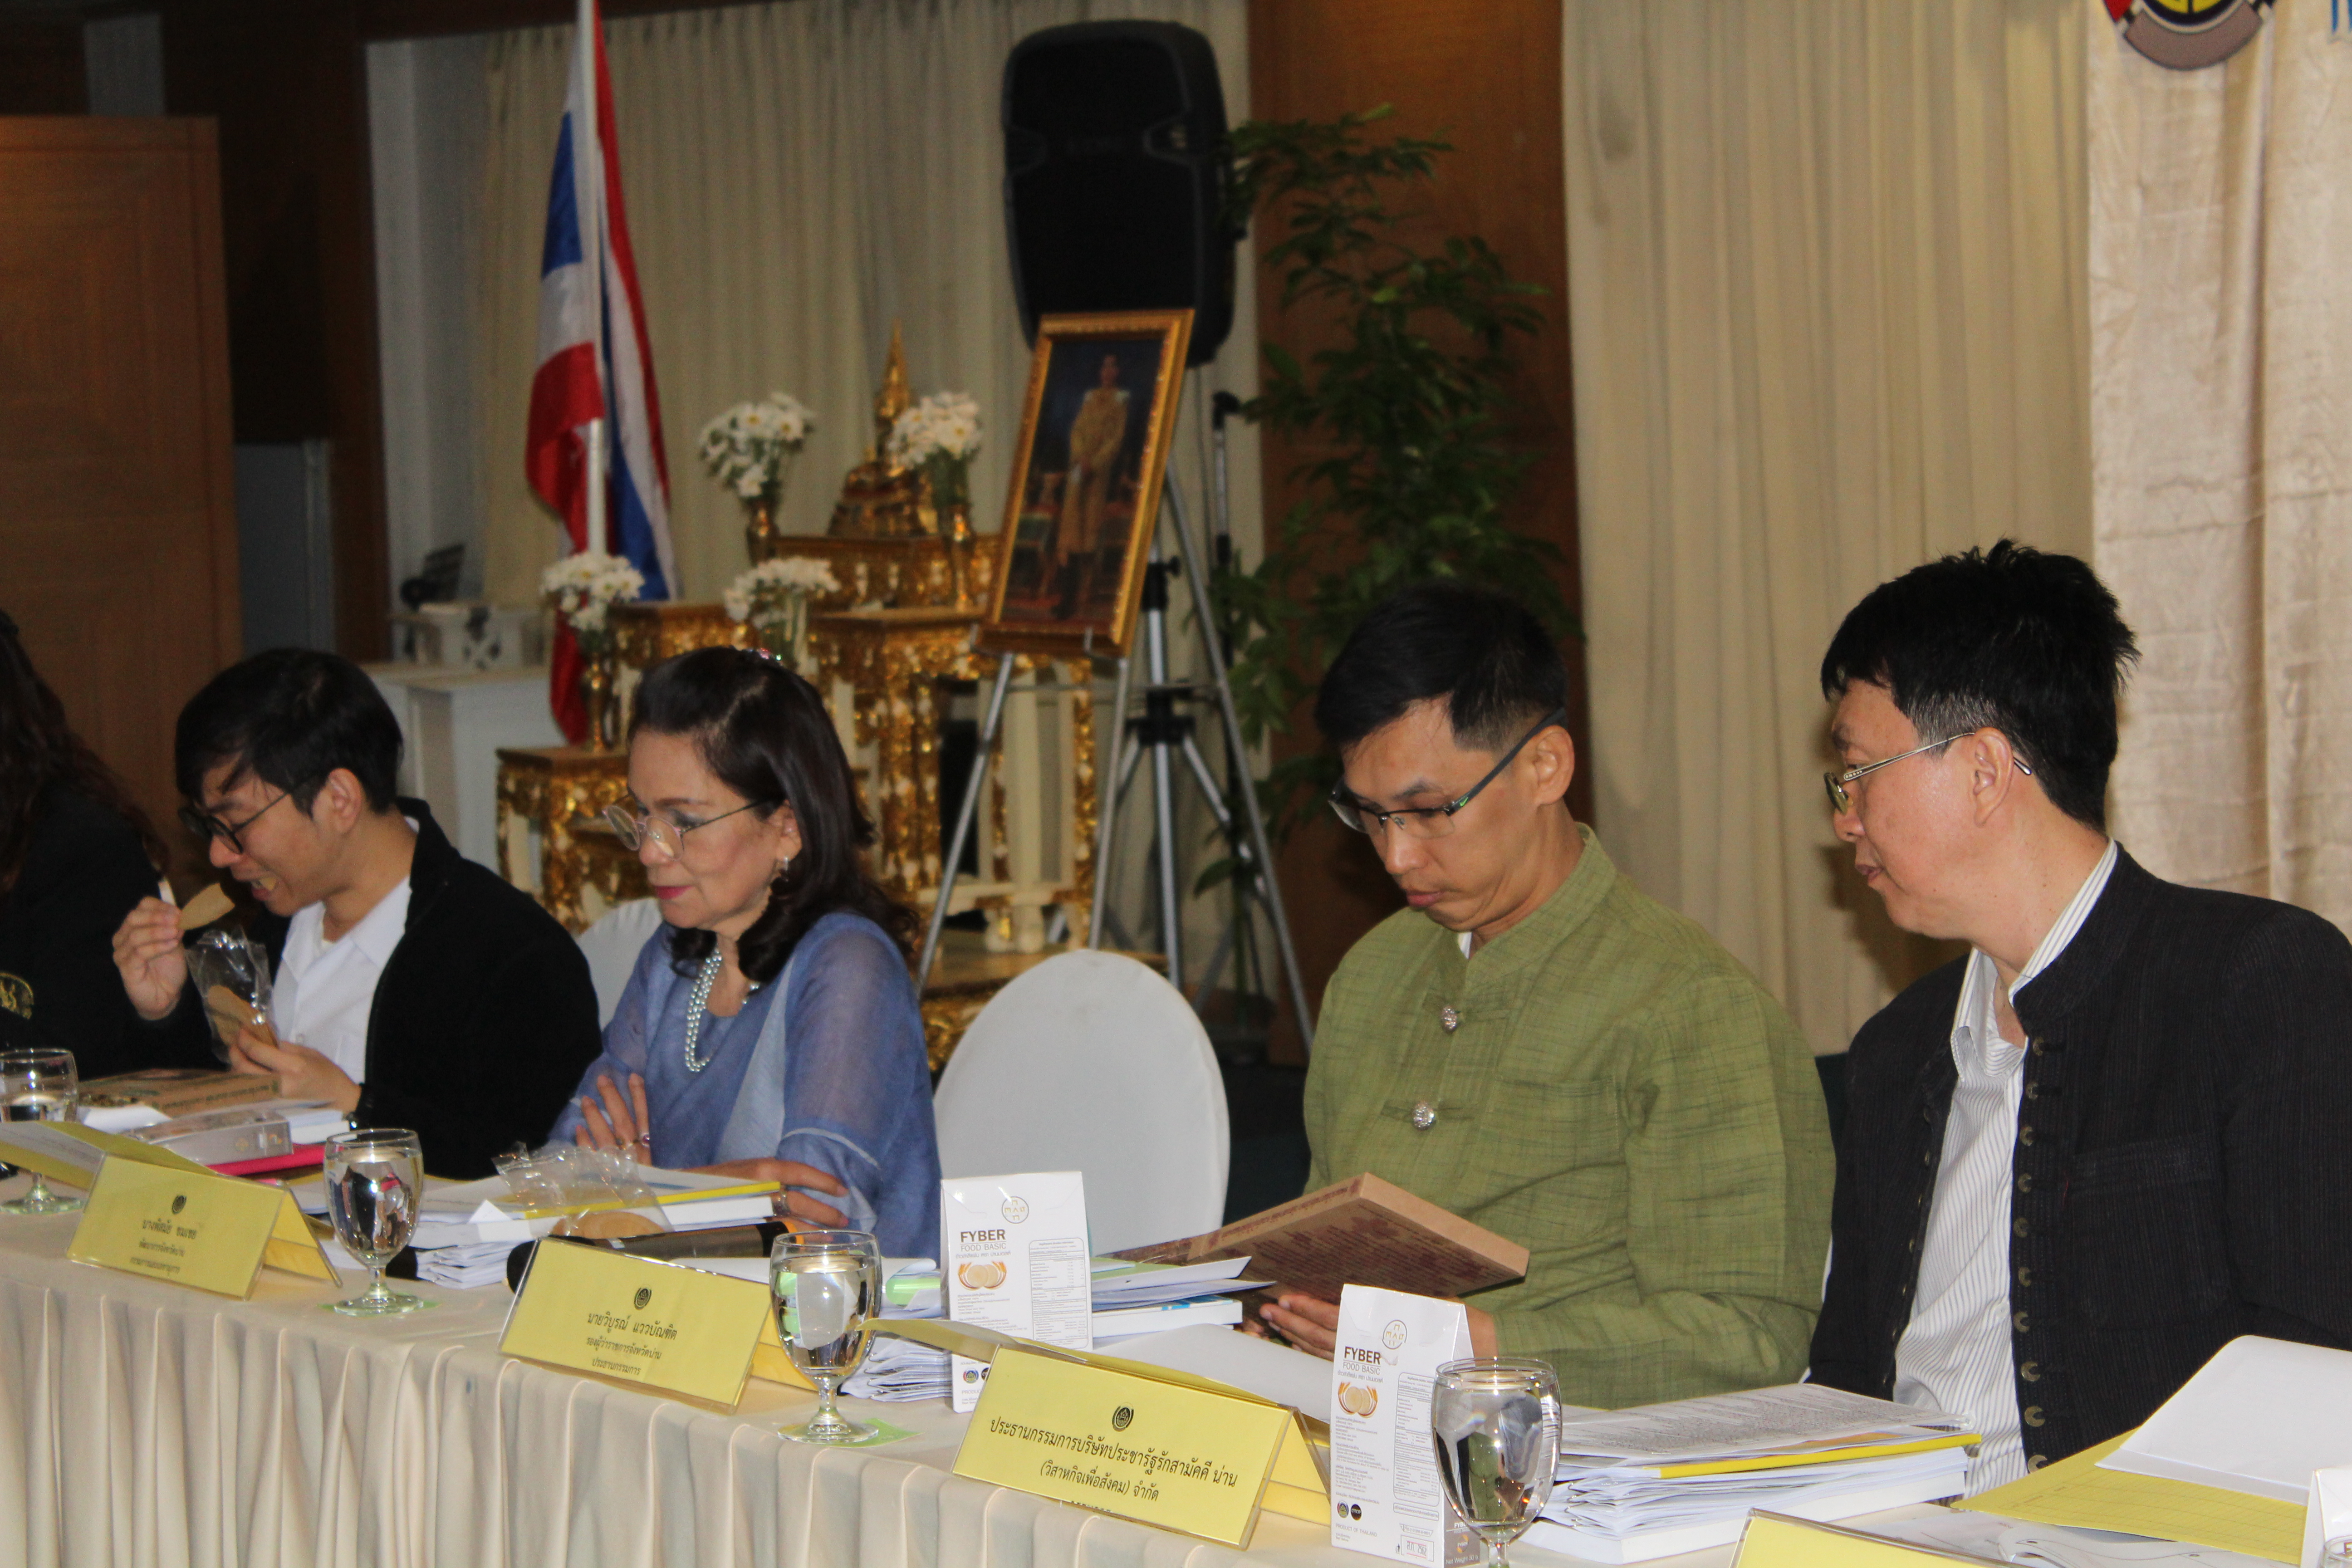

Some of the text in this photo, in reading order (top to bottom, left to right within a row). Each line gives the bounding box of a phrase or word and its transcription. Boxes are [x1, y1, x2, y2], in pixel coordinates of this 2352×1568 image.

[960, 1229, 1006, 1243] FYBER
[961, 1243, 1007, 1252] FOOD BASIC
[1344, 1346, 1381, 1365] FYBER
[592, 1357, 641, 1375] ประธานกรรมการ
[1343, 1362, 1381, 1375] FOOD BASIC
[990, 1416, 1238, 1487] ประธานกรรมการบริษัทประชารัฐรักสามัคคี น่าน
[1040, 1460, 1159, 1502] (วิสาหกิจเพื่อสังคม) จำกัด
[1335, 1524, 1352, 1532] PRODUCT
[1360, 1529, 1377, 1537] THAILAND
